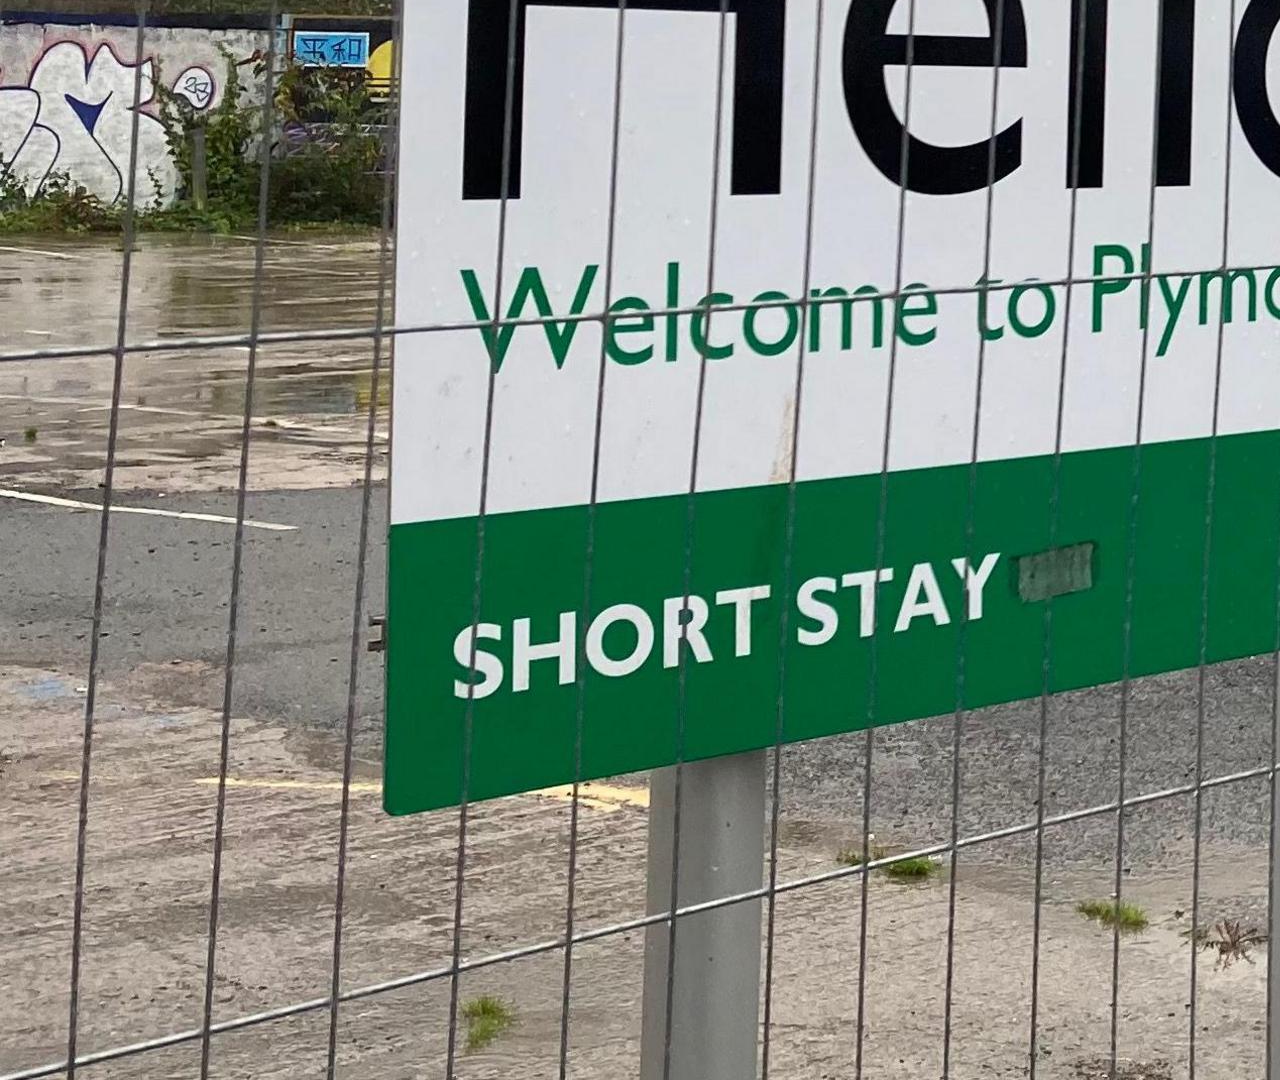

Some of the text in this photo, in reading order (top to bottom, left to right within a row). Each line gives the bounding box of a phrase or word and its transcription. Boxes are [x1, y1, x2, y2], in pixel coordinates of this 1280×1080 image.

[300, 37, 363, 62] 平和
[461, 262, 938, 372] Welcome
[978, 275, 1057, 340] to
[453, 552, 1002, 700] SHORT STAY
